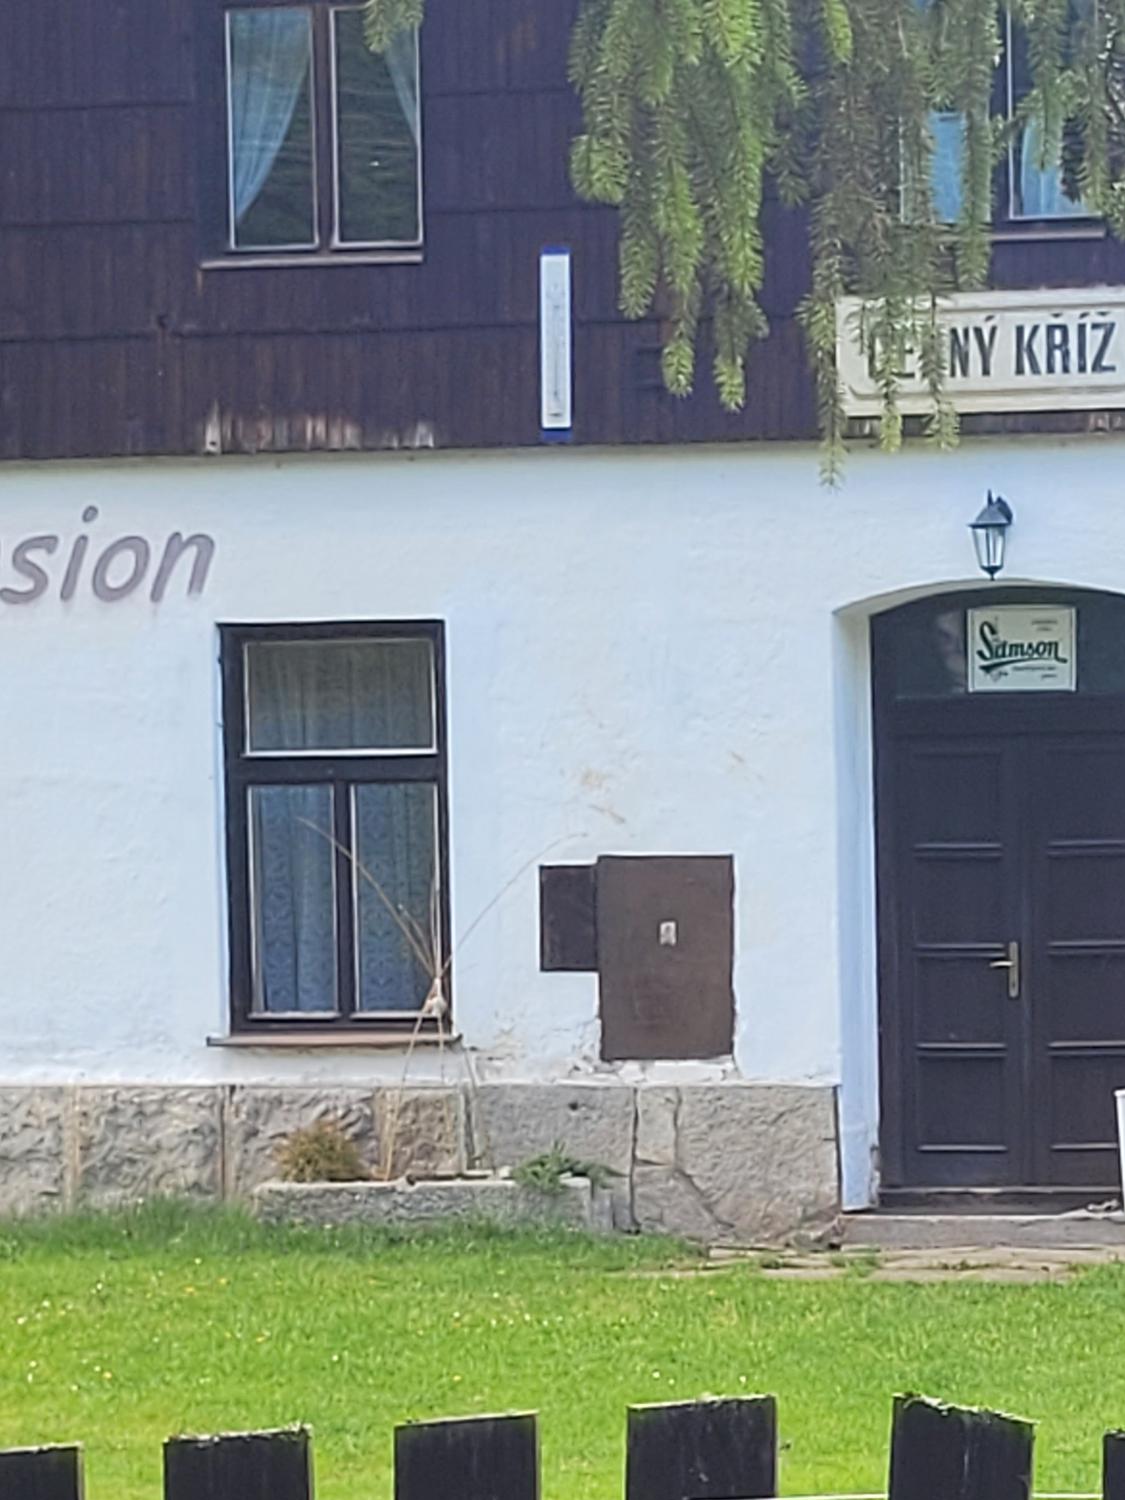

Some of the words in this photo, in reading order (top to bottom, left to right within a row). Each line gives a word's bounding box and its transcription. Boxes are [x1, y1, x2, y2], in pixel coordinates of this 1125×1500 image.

[868, 313, 997, 378] ENÝ
[1014, 311, 1117, 376] KŘÍŽ
[0, 505, 215, 604] sion
[976, 620, 1068, 664] Samson
